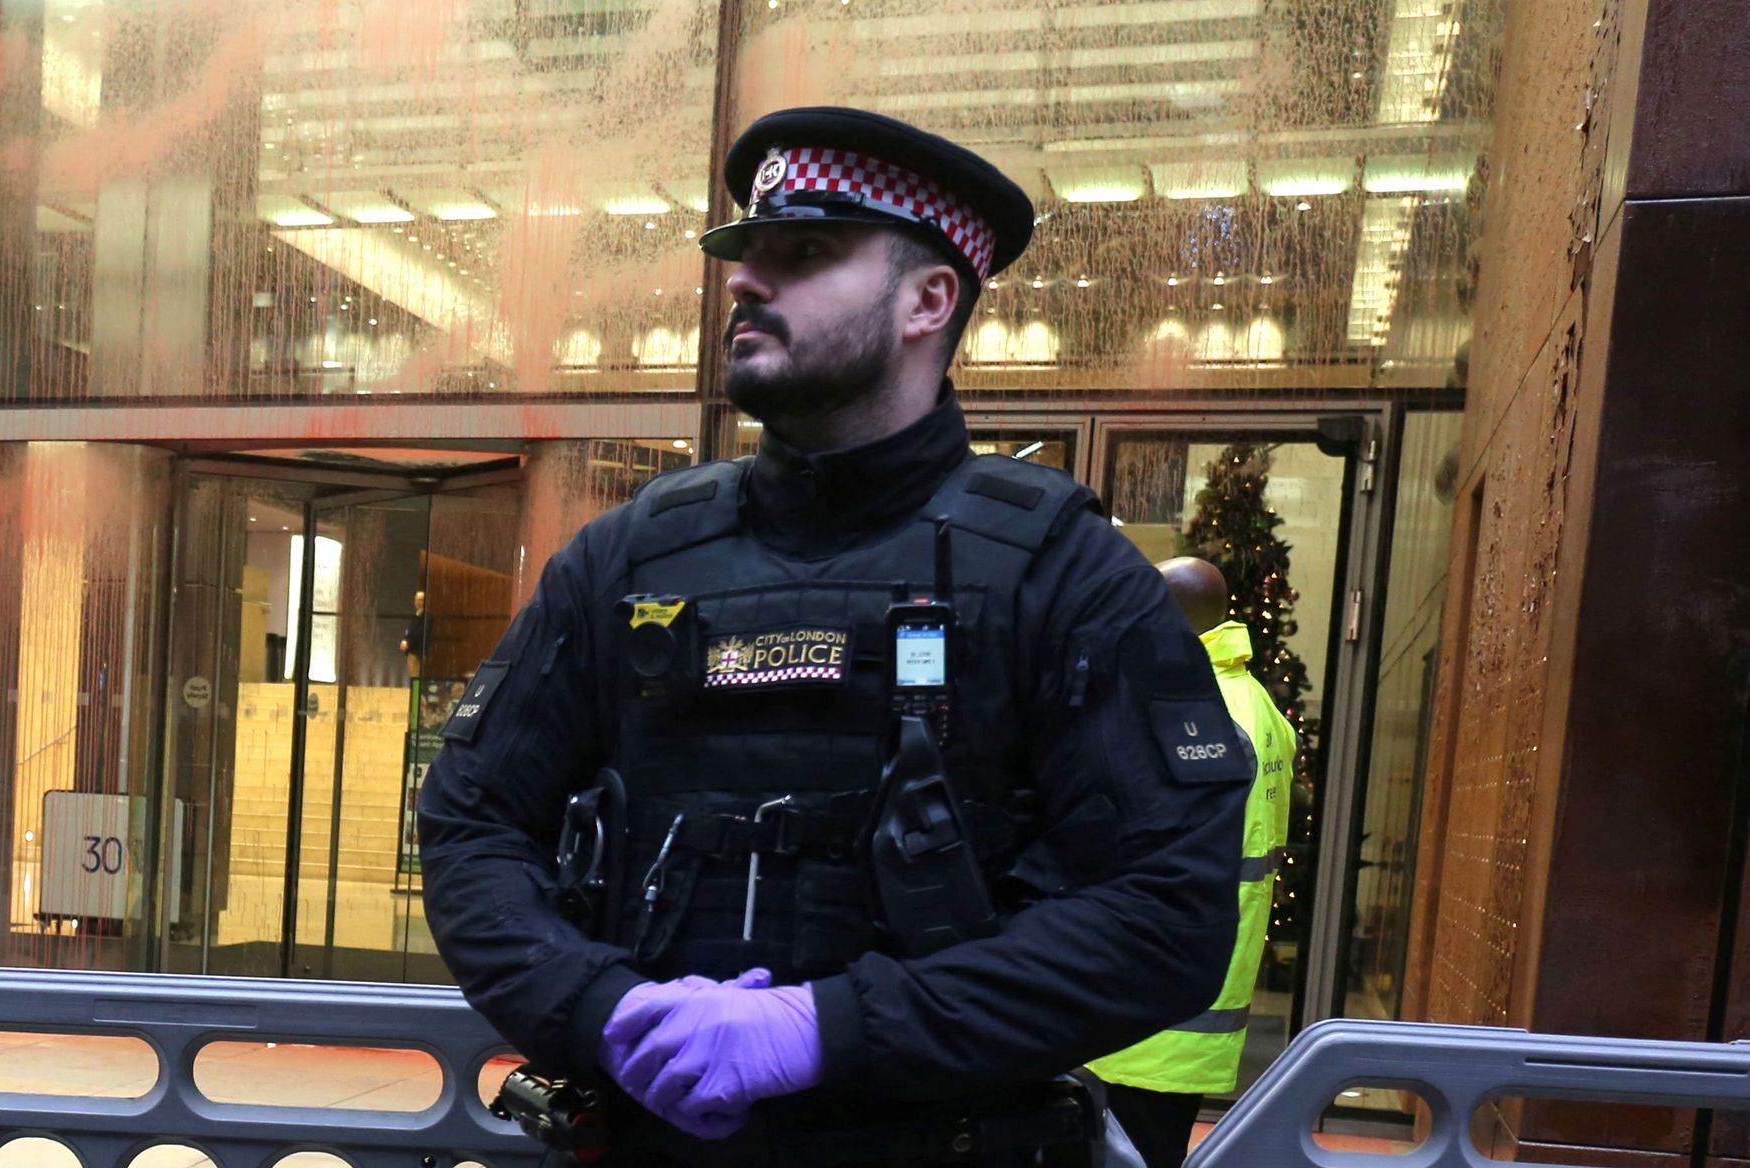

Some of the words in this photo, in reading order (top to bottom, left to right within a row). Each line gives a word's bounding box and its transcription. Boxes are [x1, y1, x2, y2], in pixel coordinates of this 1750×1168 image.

[755, 633, 782, 646] CITY
[790, 630, 846, 644] LONDON
[753, 644, 843, 669] POLICE
[1184, 721, 1198, 737] U
[82, 835, 123, 875] 30
